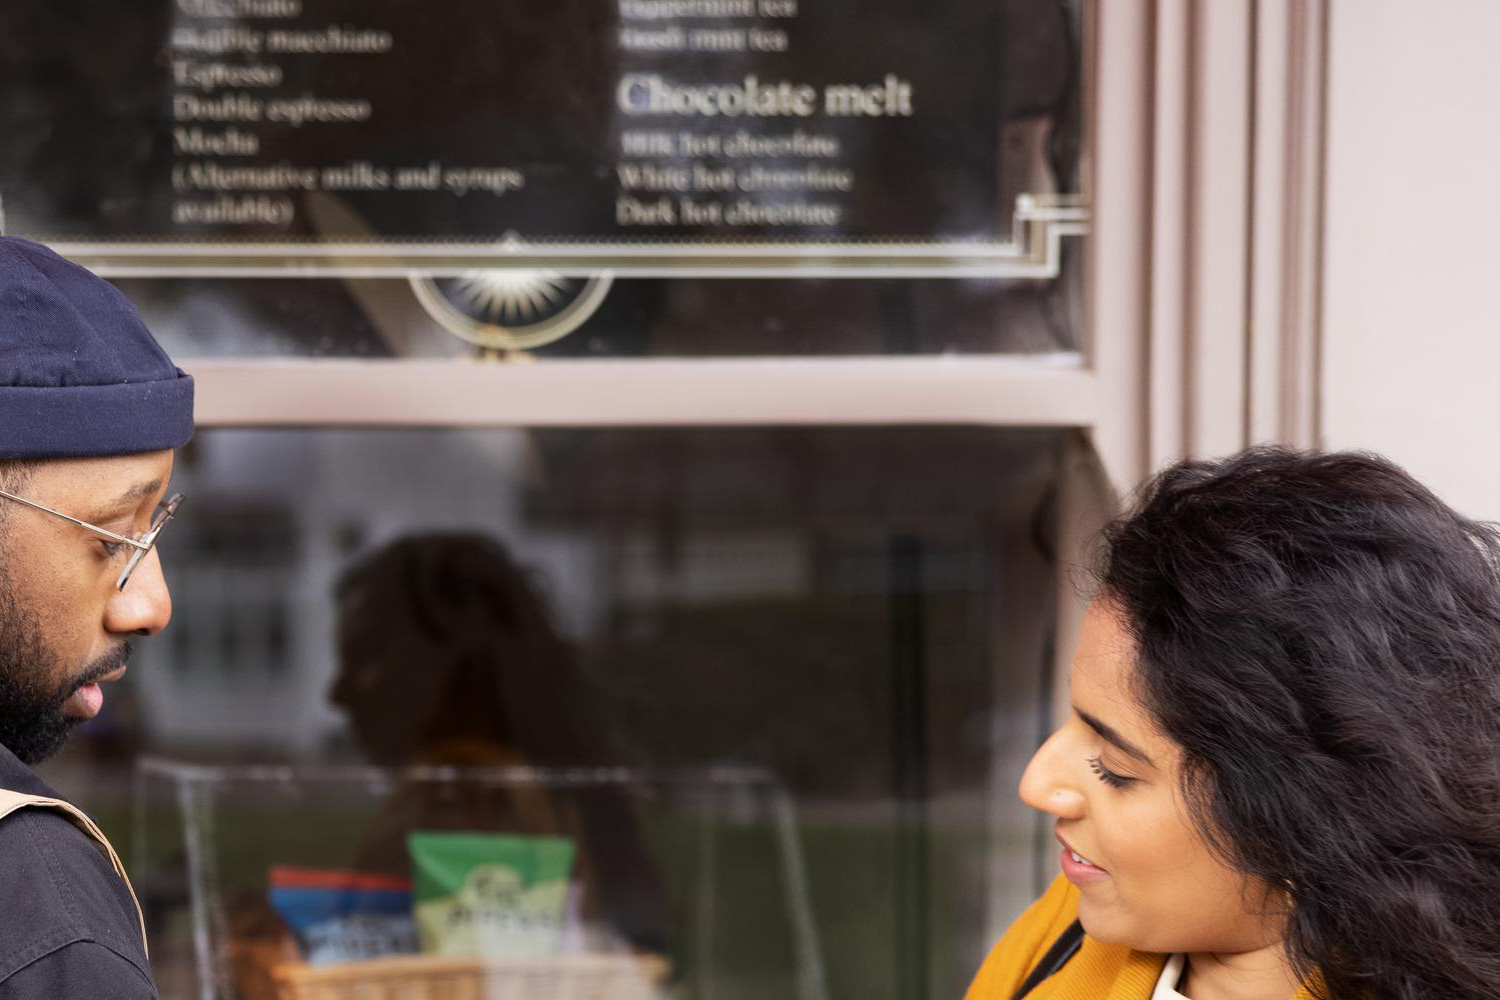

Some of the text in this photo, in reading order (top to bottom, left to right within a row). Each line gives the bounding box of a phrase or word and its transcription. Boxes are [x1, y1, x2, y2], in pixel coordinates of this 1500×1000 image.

[758, 0, 797, 17] tea
[266, 23, 393, 54] macchiato
[689, 28, 747, 51] mint
[749, 29, 790, 52] tea
[172, 60, 283, 92] Espresso
[173, 93, 372, 127] Double espresso
[617, 73, 915, 117] Chocolate melt
[173, 126, 260, 156] Mocha
[677, 131, 722, 157] hot
[723, 130, 841, 158] chocolate
[171, 160, 526, 196] (Alternative milks and syrups
[617, 164, 855, 192] White hot chocolate
[172, 194, 295, 227] available)
[615, 197, 844, 226] Dark hot chocolate
